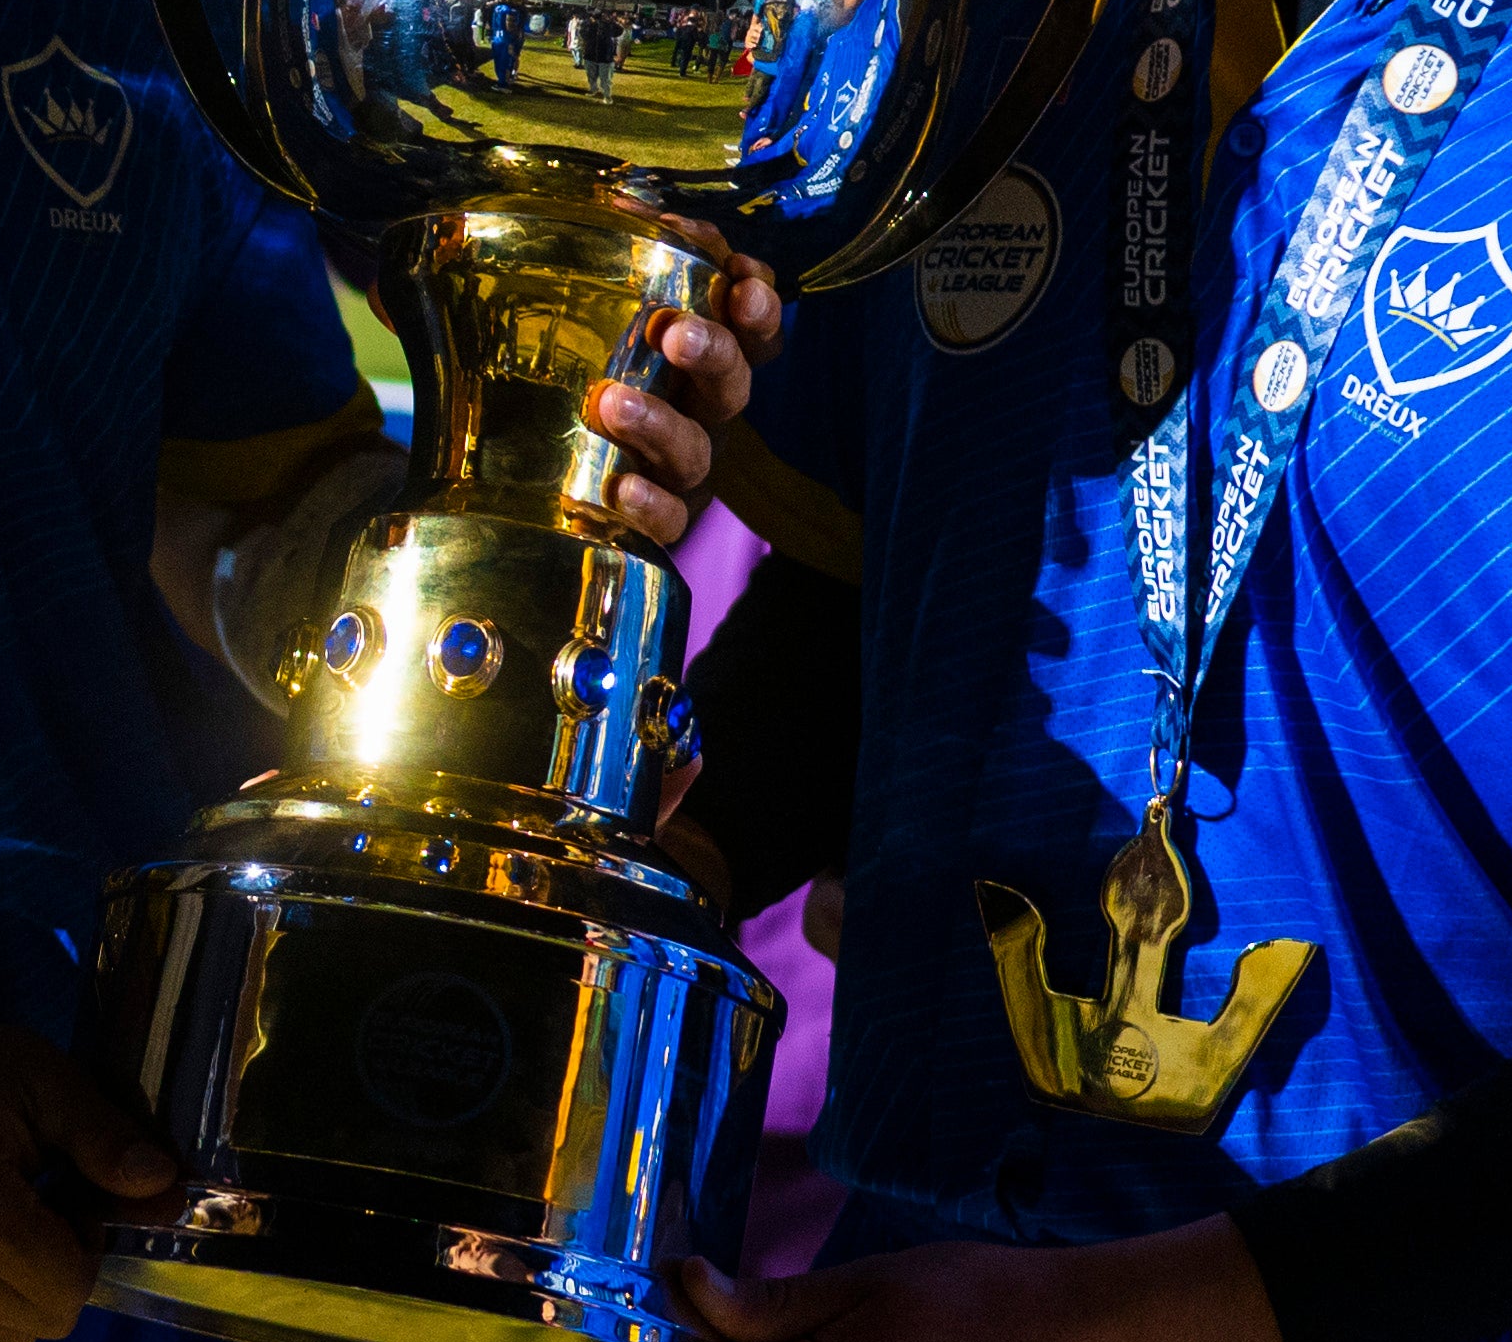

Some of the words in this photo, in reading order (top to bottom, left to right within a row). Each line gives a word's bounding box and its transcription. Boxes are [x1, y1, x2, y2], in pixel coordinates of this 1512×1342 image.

[1395, 48, 1428, 102] EUROPEAN
[1403, 50, 1438, 109] CRICKET
[1421, 59, 1445, 100] LEAGUE
[49, 207, 123, 234] DREUX
[1125, 133, 1147, 307] EUROPEAN
[1144, 129, 1170, 307] CRICKET
[1286, 131, 1382, 311] EUROPEAN
[1307, 138, 1405, 318] CRICKET
[926, 246, 1044, 269] CRICKET
[941, 273, 1026, 292] LEAGUE
[1269, 347, 1294, 408] CRICKET
[1341, 373, 1428, 440] DREUX
[1147, 435, 1175, 622] CRICKET
[1112, 1045, 1153, 1060] OPEAN
